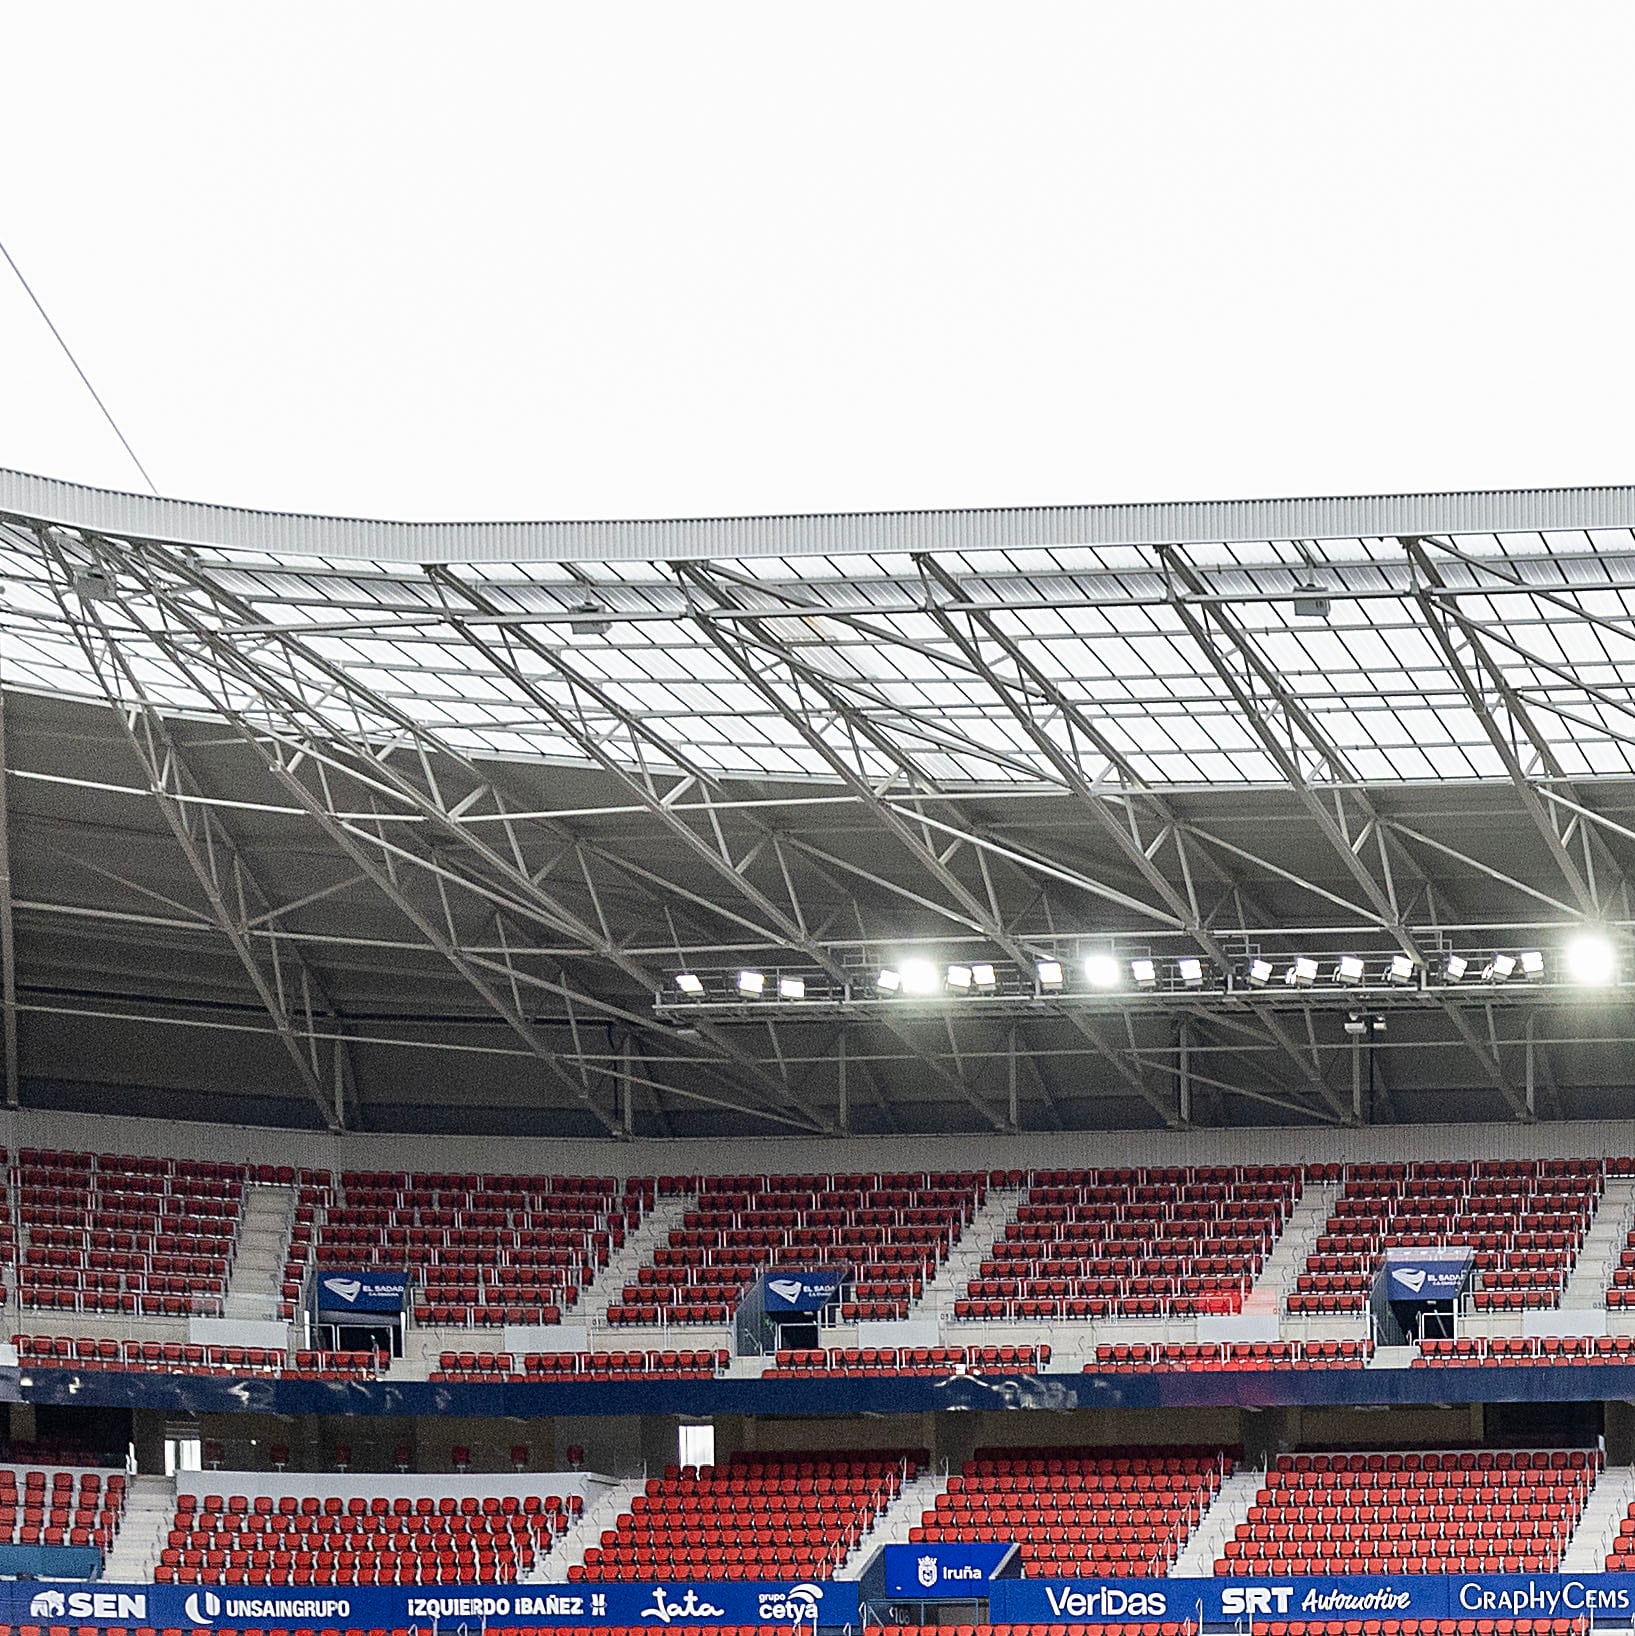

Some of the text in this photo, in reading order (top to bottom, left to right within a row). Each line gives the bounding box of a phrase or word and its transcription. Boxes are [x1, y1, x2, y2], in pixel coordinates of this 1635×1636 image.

[942, 1565, 982, 1580] Iruña
[68, 1592, 146, 1619] SEN
[226, 1598, 351, 1618] UNSAINGRUPO
[640, 1587, 725, 1623] Jata
[758, 1592, 787, 1604] grupo
[1045, 1586, 1167, 1616] VeriDas
[1221, 1587, 1412, 1614] SRT Automotive
[758, 1603, 819, 1626] cetya
